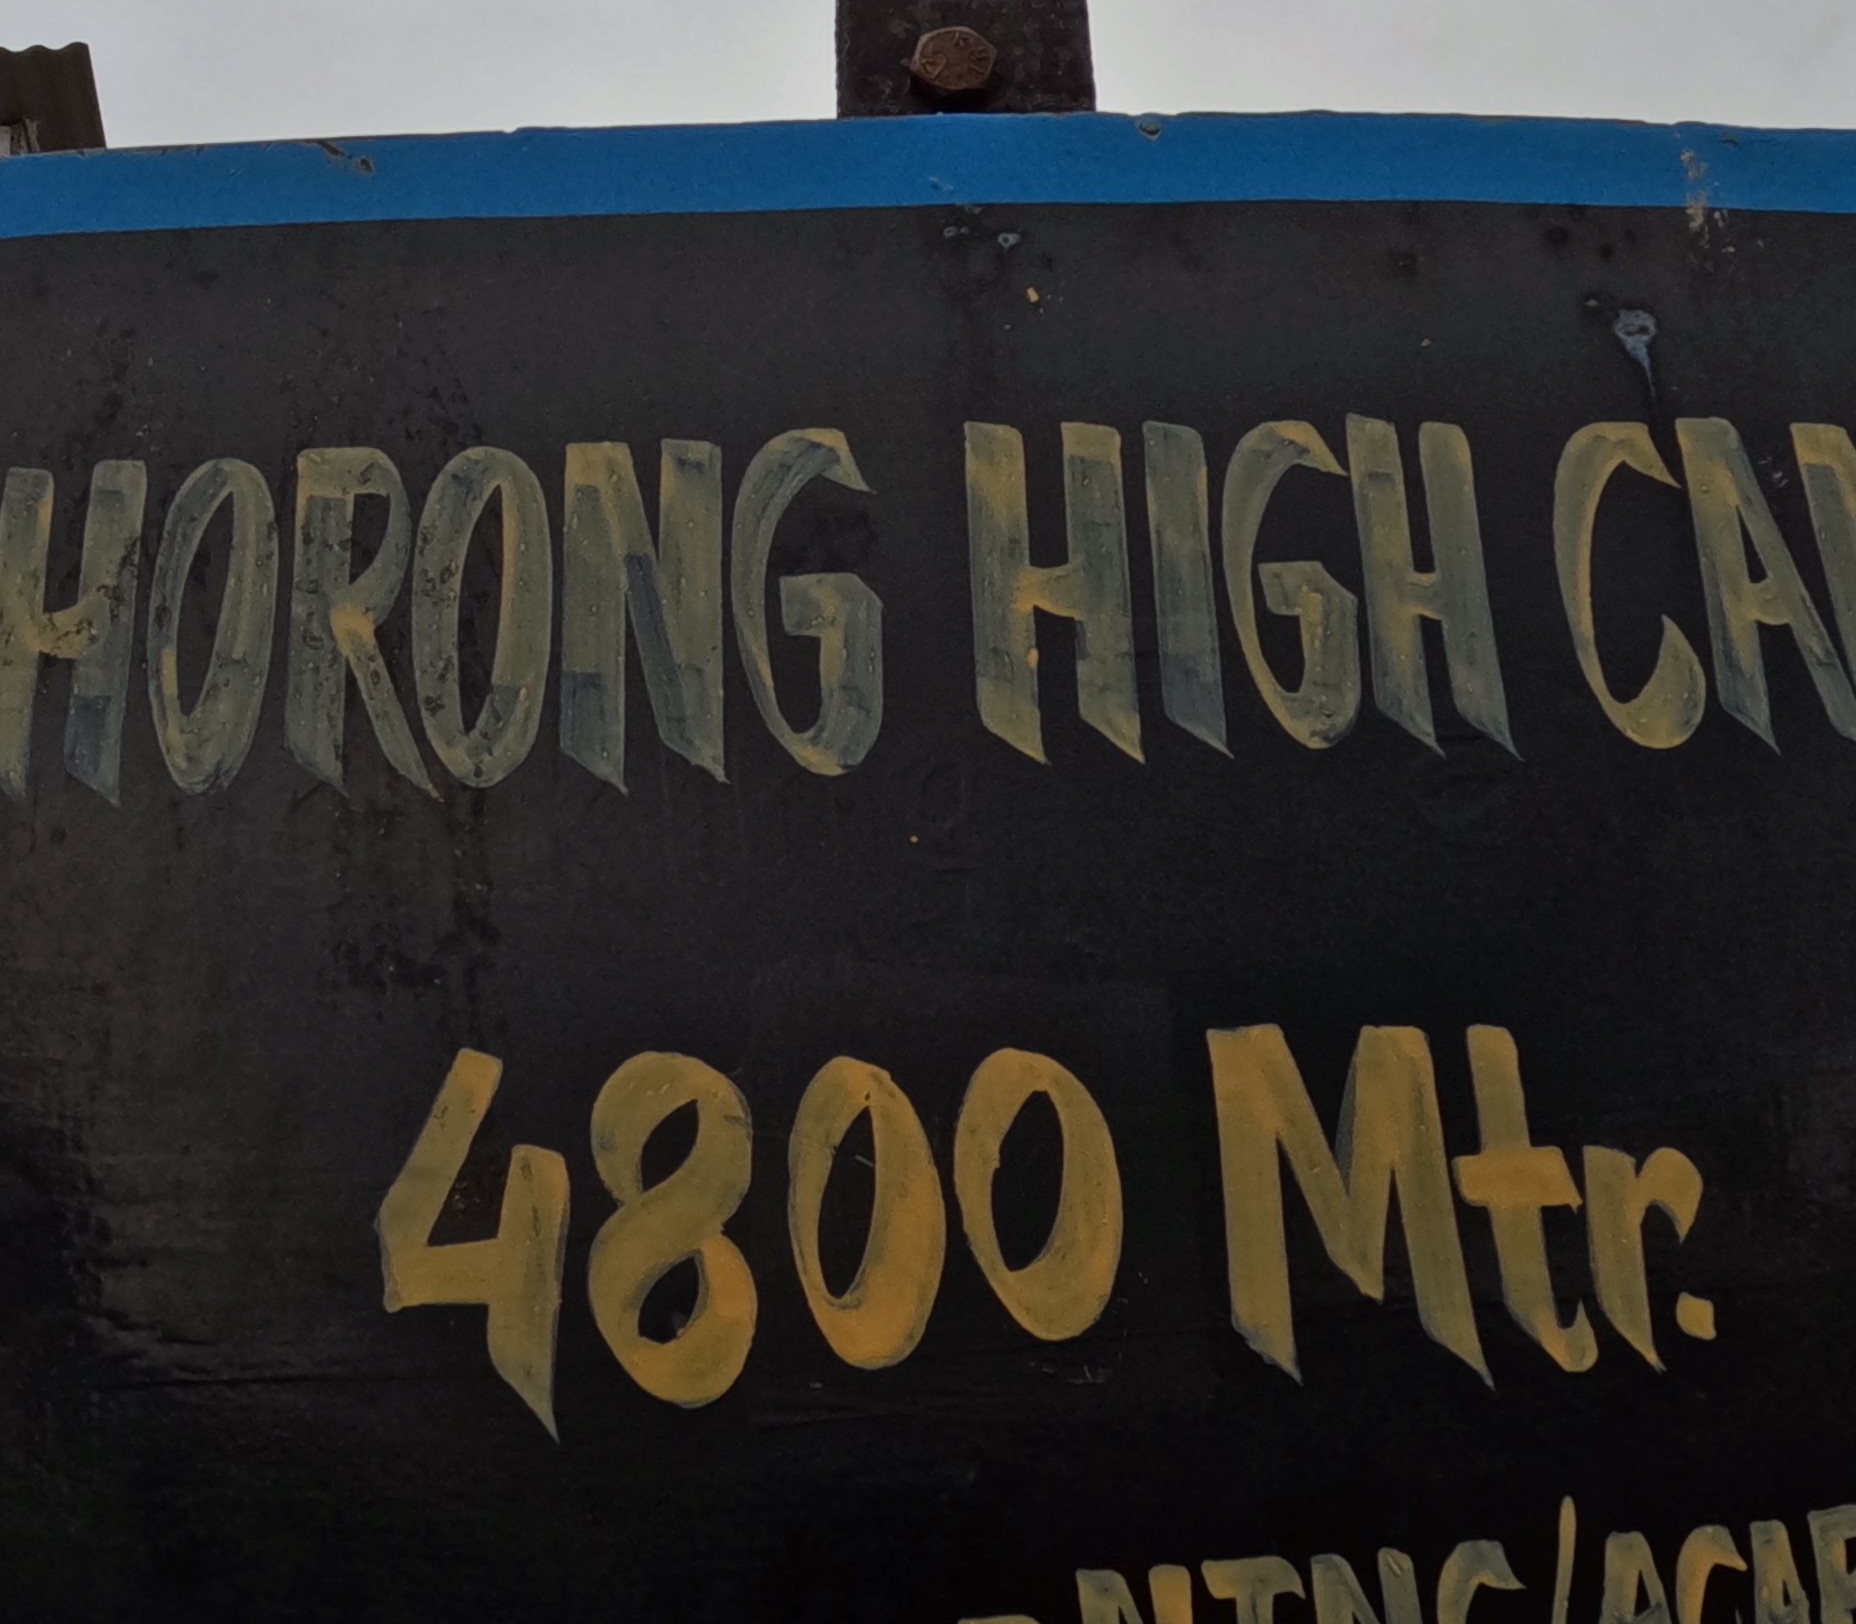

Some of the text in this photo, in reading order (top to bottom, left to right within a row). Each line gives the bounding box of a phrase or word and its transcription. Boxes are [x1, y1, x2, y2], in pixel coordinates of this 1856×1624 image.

[964, 413, 1525, 765] HIGH
[375, 1024, 1716, 1443] 4800 Mtr.
